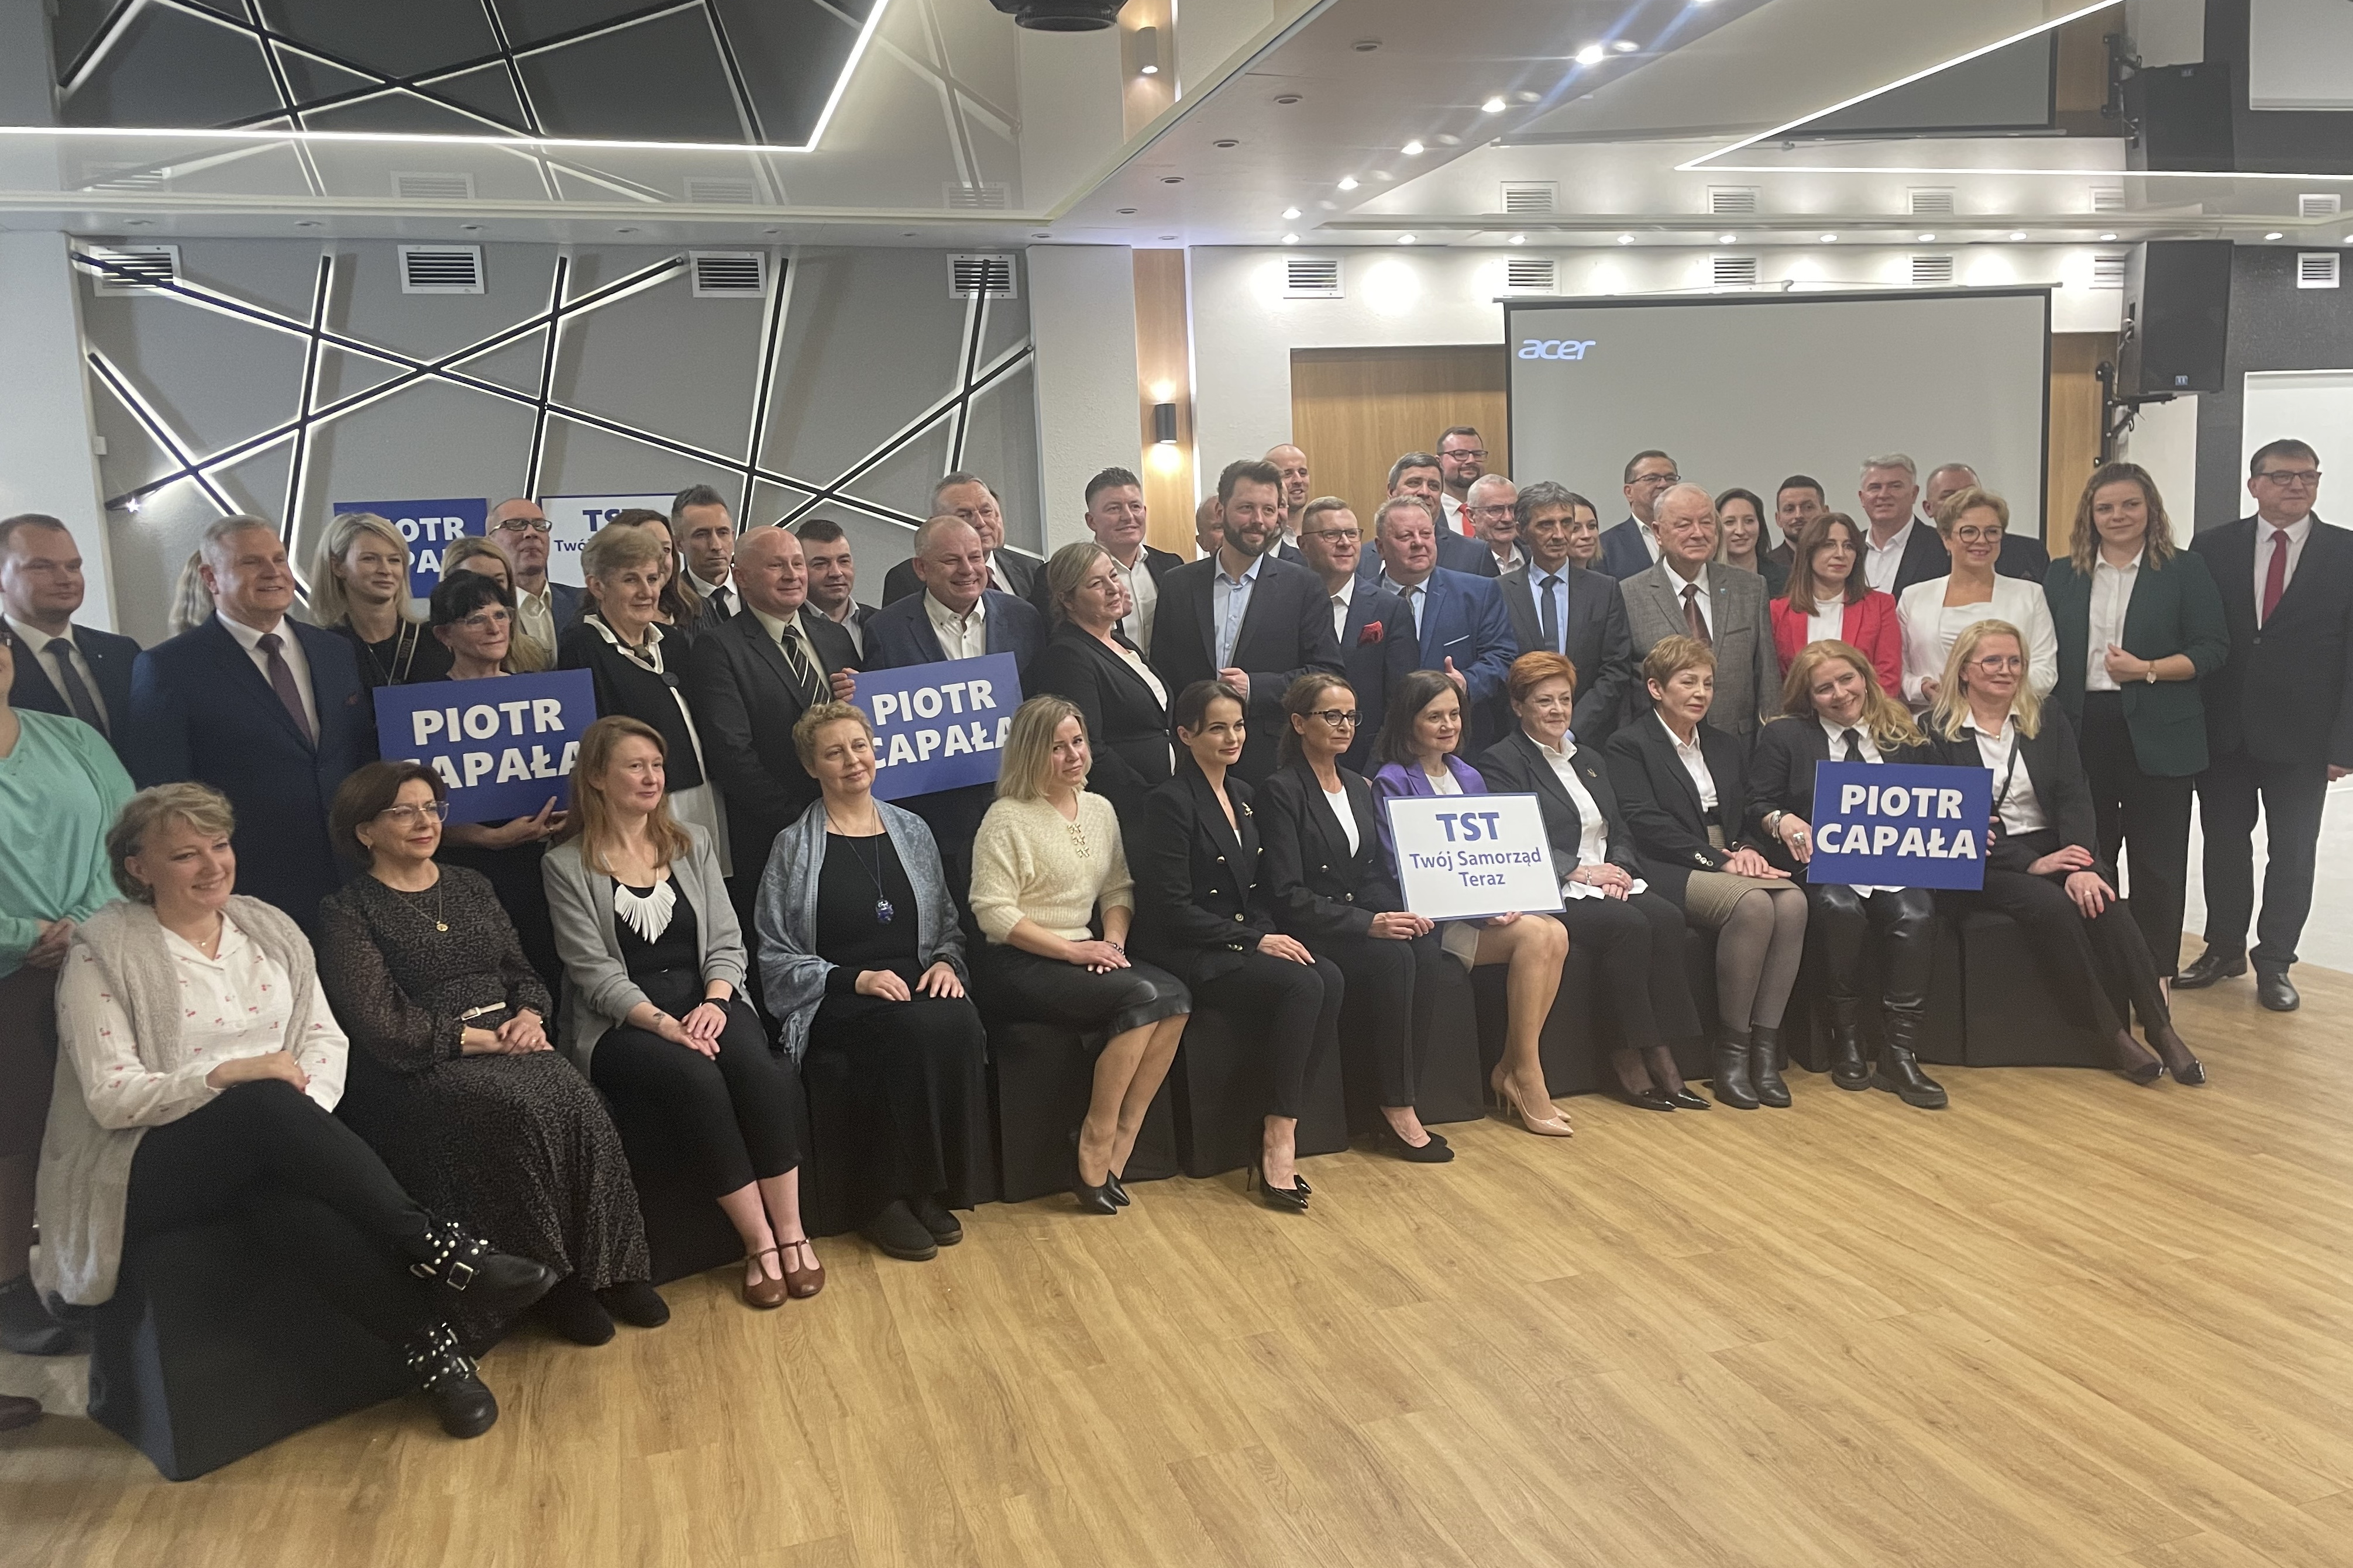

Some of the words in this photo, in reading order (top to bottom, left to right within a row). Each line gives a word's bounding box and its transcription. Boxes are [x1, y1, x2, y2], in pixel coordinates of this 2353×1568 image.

[1518, 339, 1596, 360] acer
[388, 517, 465, 542] OTR
[554, 539, 590, 552] Twó
[872, 680, 997, 726] PIOTR
[412, 698, 565, 746] PIOTR
[404, 741, 581, 789] APAŁA
[1841, 784, 1963, 819] PIOTR
[1436, 812, 1499, 842] TST
[1817, 823, 1977, 859] CAPAŁA
[1409, 851, 1453, 871] Twój
[1457, 847, 1542, 867] Samorząd
[1458, 872, 1506, 887] Teraz
